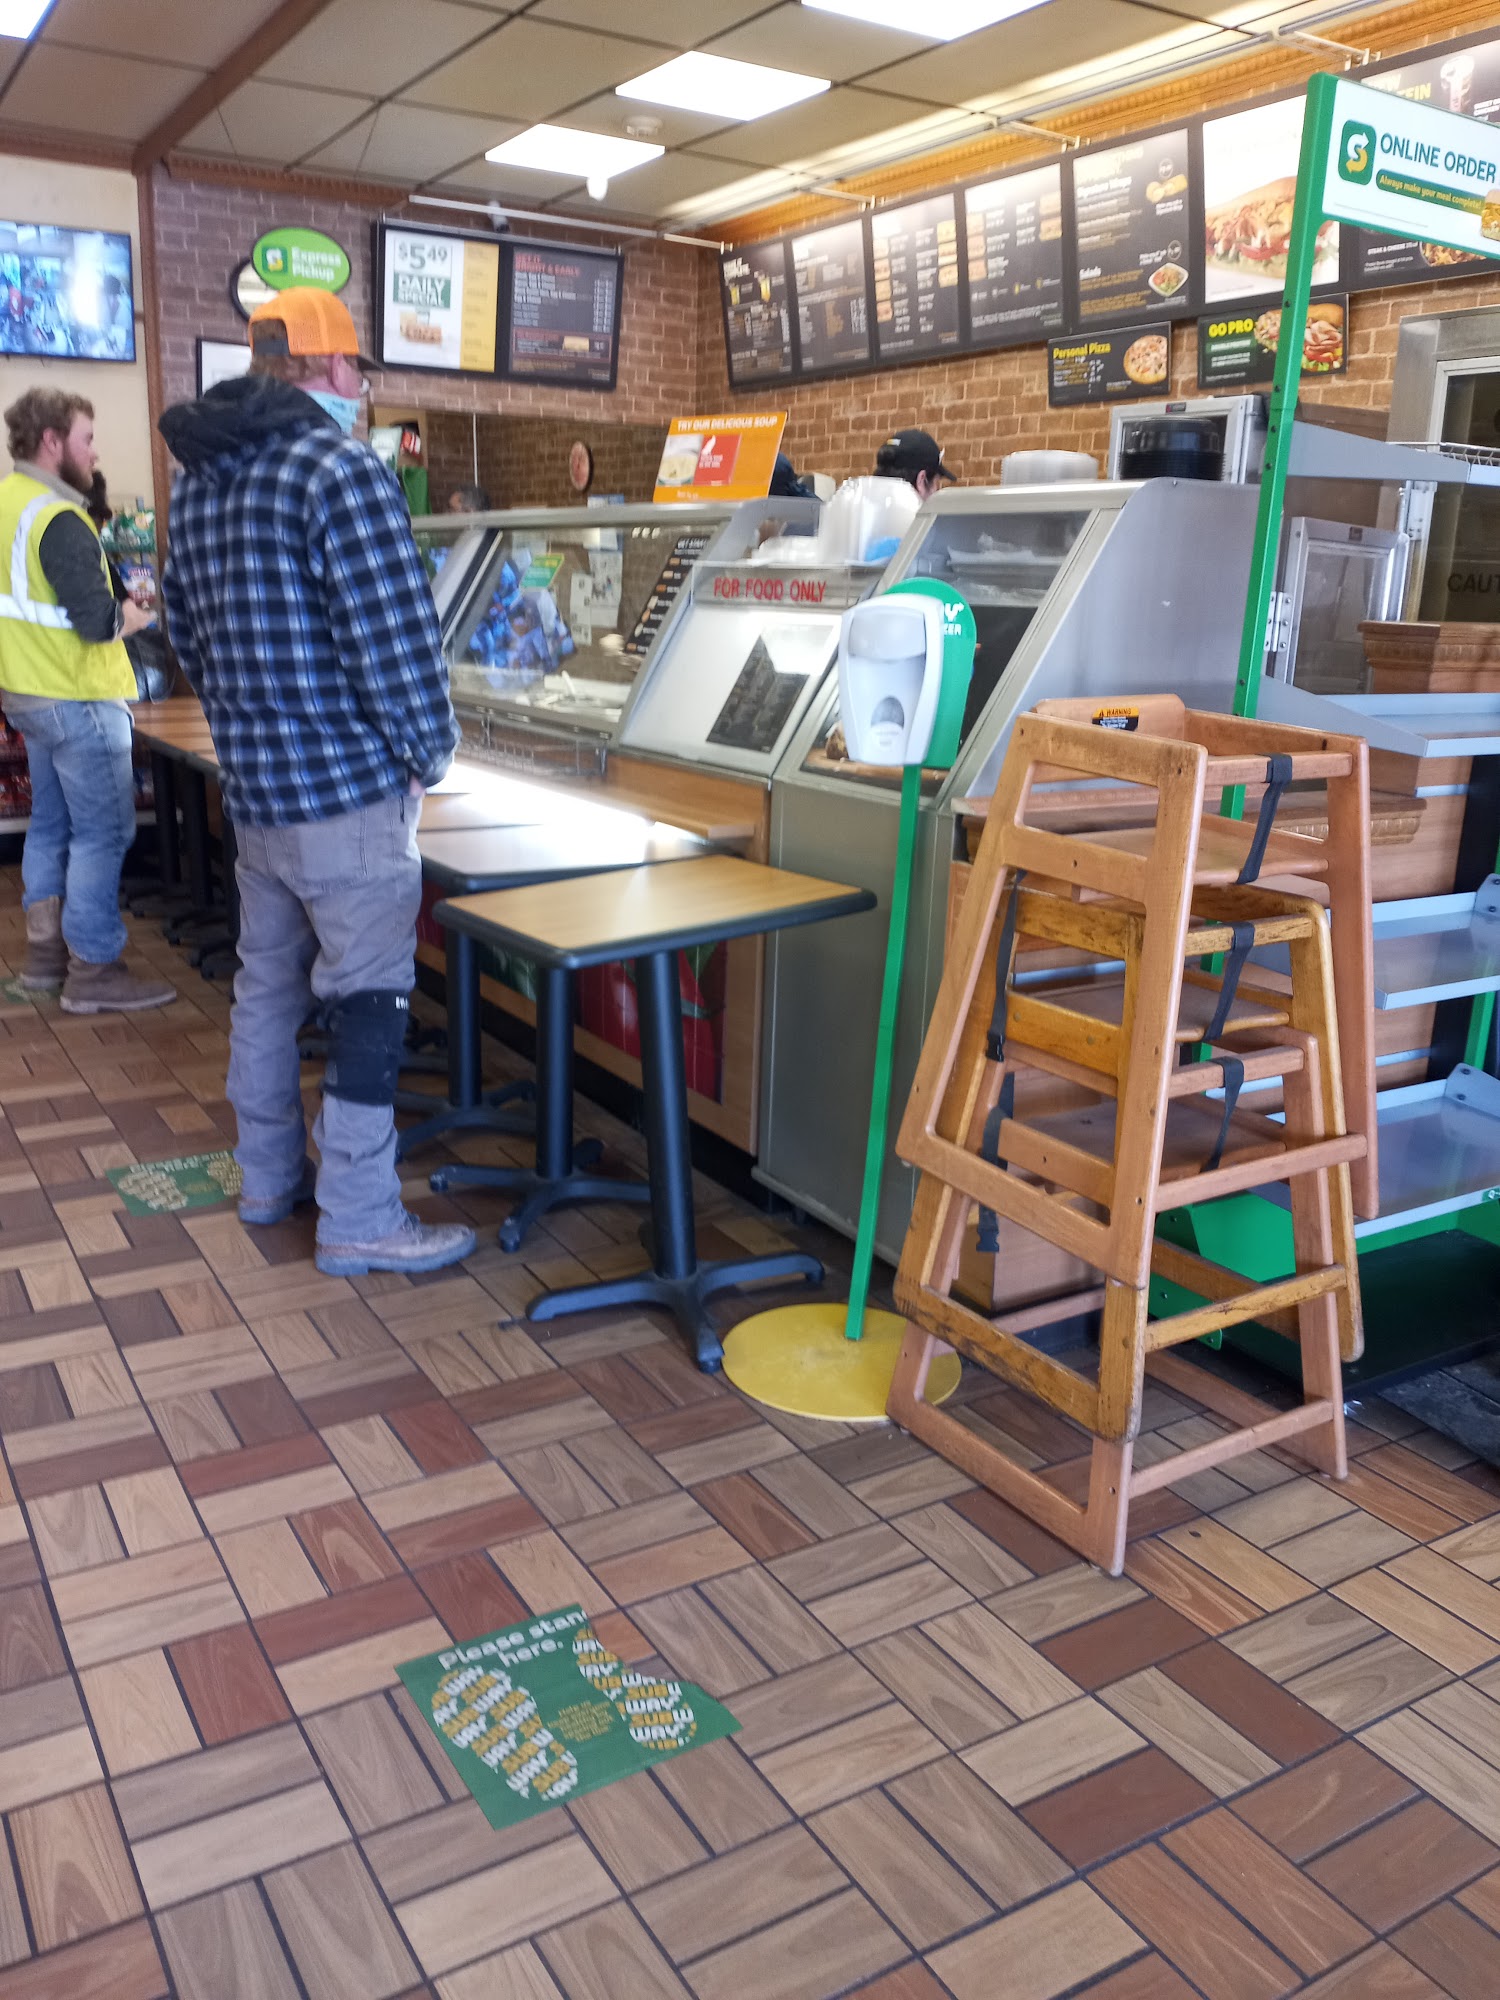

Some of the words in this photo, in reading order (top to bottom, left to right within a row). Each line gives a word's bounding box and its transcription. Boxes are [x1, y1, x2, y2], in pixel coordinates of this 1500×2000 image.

[1381, 133, 1441, 168] ONLINE
[1444, 151, 1497, 183] ORDER
[1379, 174, 1404, 191] Always
[1404, 181, 1421, 194] make
[1421, 187, 1437, 198] your
[1437, 191, 1452, 202] meal
[1452, 196, 1482, 210] complete!
[291, 246, 342, 268] Express
[292, 262, 335, 283] Pickup
[399, 275, 446, 296] DAILY
[398, 290, 444, 308] SPECIAL
[1208, 322, 1228, 338] GO
[1228, 318, 1254, 335] PRO
[1053, 343, 1088, 359] Personal
[1088, 342, 1112, 355] Pizza
[677, 420, 693, 432] TRY
[693, 419, 710, 430] OUR
[711, 416, 754, 430] DELICIOUS
[754, 415, 778, 428] SOUP
[714, 577, 740, 599] FOR
[745, 578, 784, 601] FOOD
[789, 578, 827, 603] ONLY
[1106, 707, 1132, 717] WARNING
[438, 1631, 525, 1671] Please
[497, 1638, 564, 1668] here.
